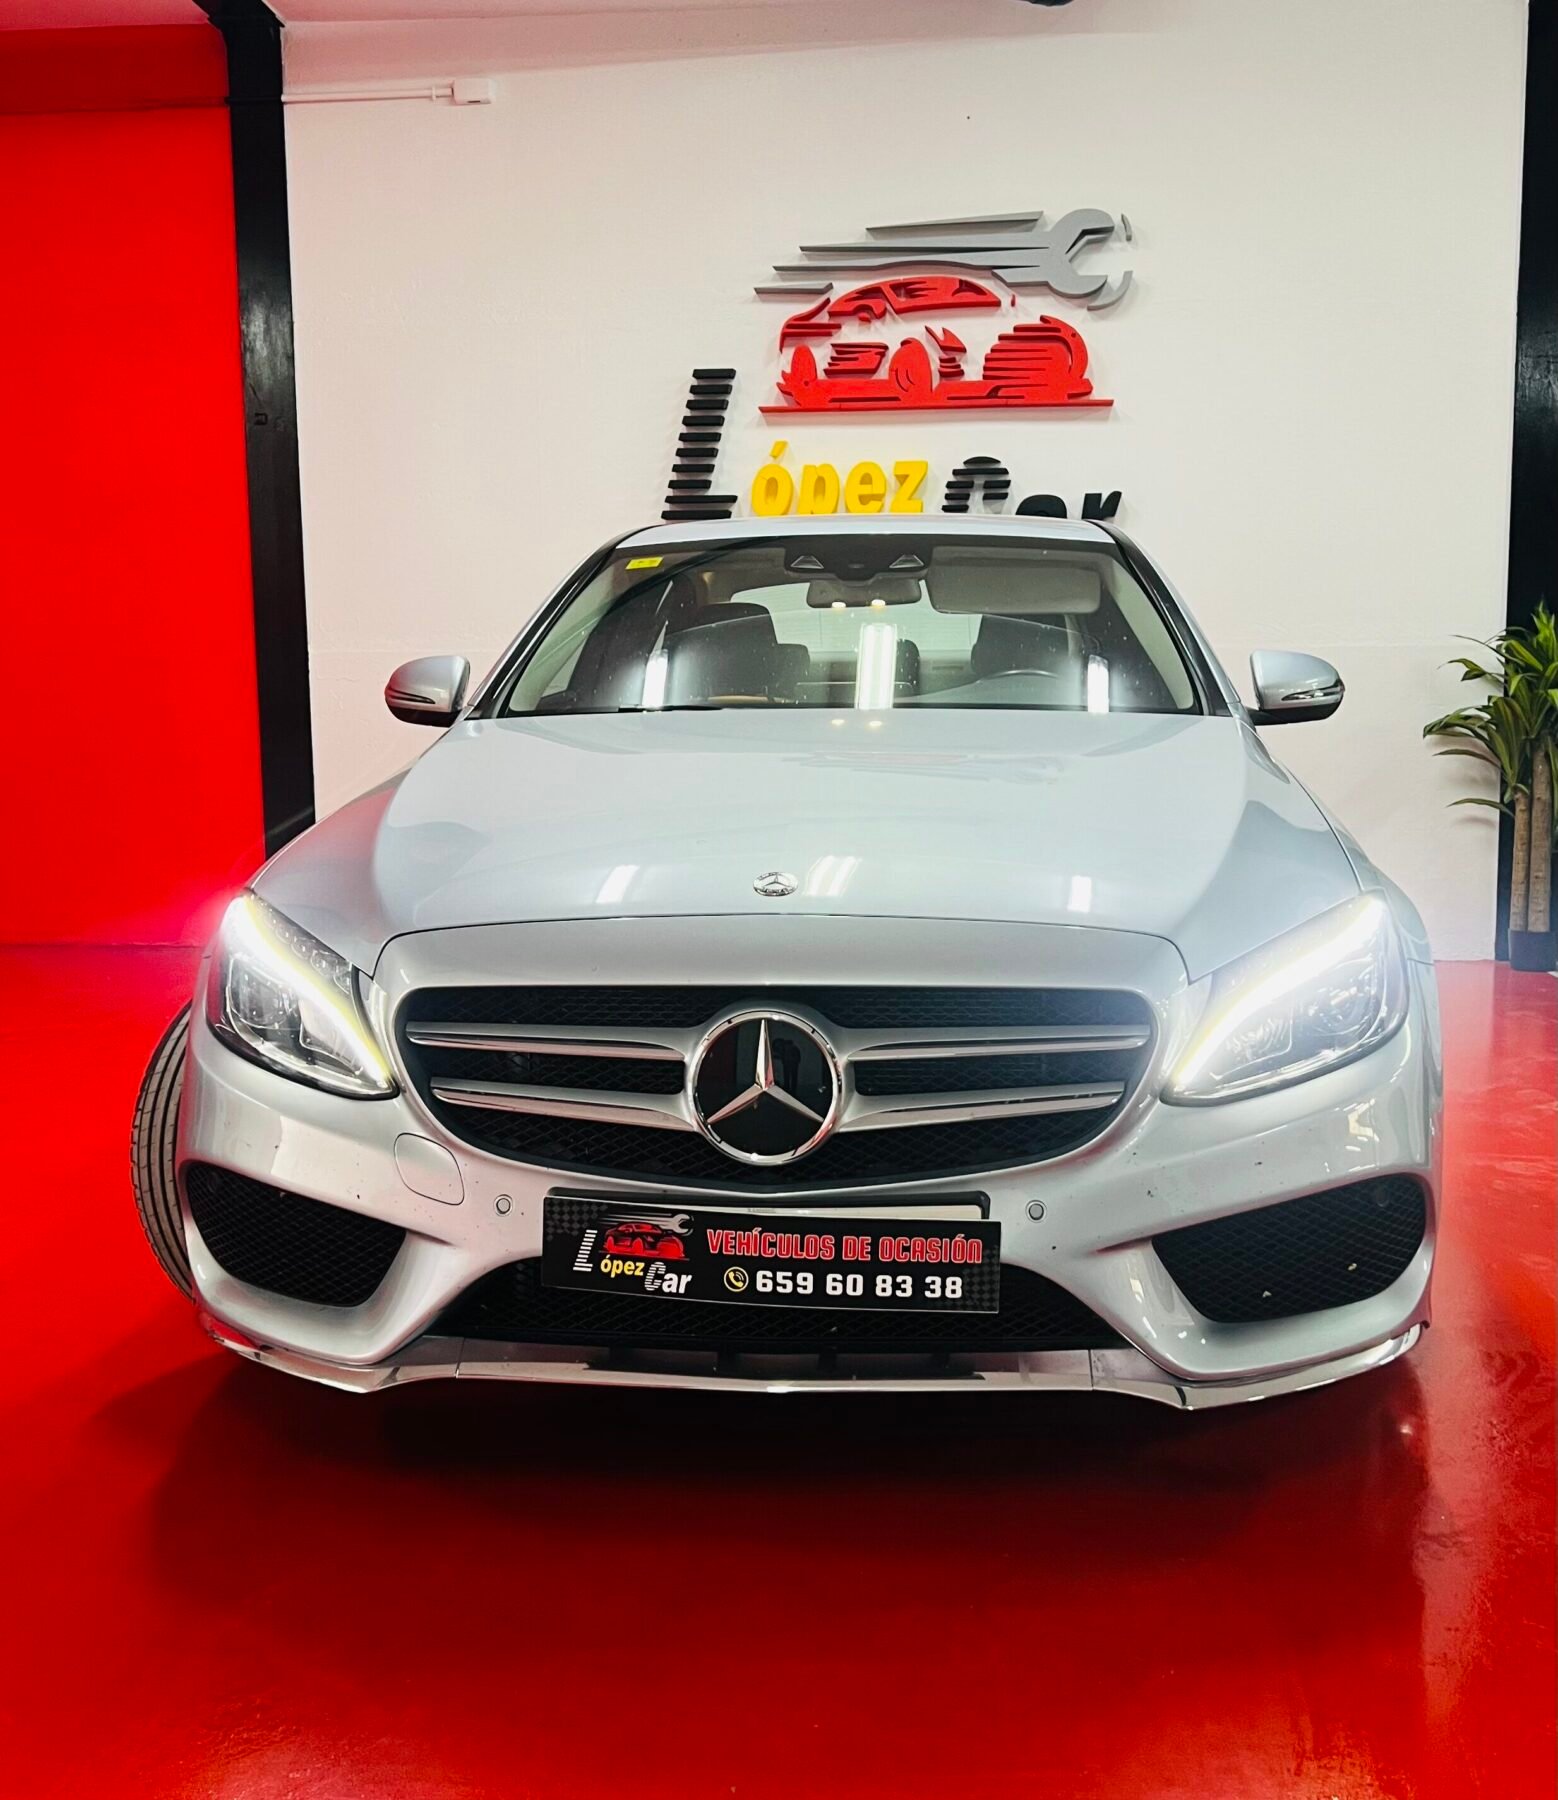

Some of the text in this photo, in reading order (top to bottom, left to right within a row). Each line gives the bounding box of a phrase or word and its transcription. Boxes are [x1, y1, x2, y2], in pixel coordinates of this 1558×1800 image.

[661, 368, 929, 519] López
[573, 1229, 693, 1294] López Car
[706, 1227, 983, 1264] VEHÍCULOS DE OCASIÓN
[756, 1270, 963, 1299] 659 60 83 38
